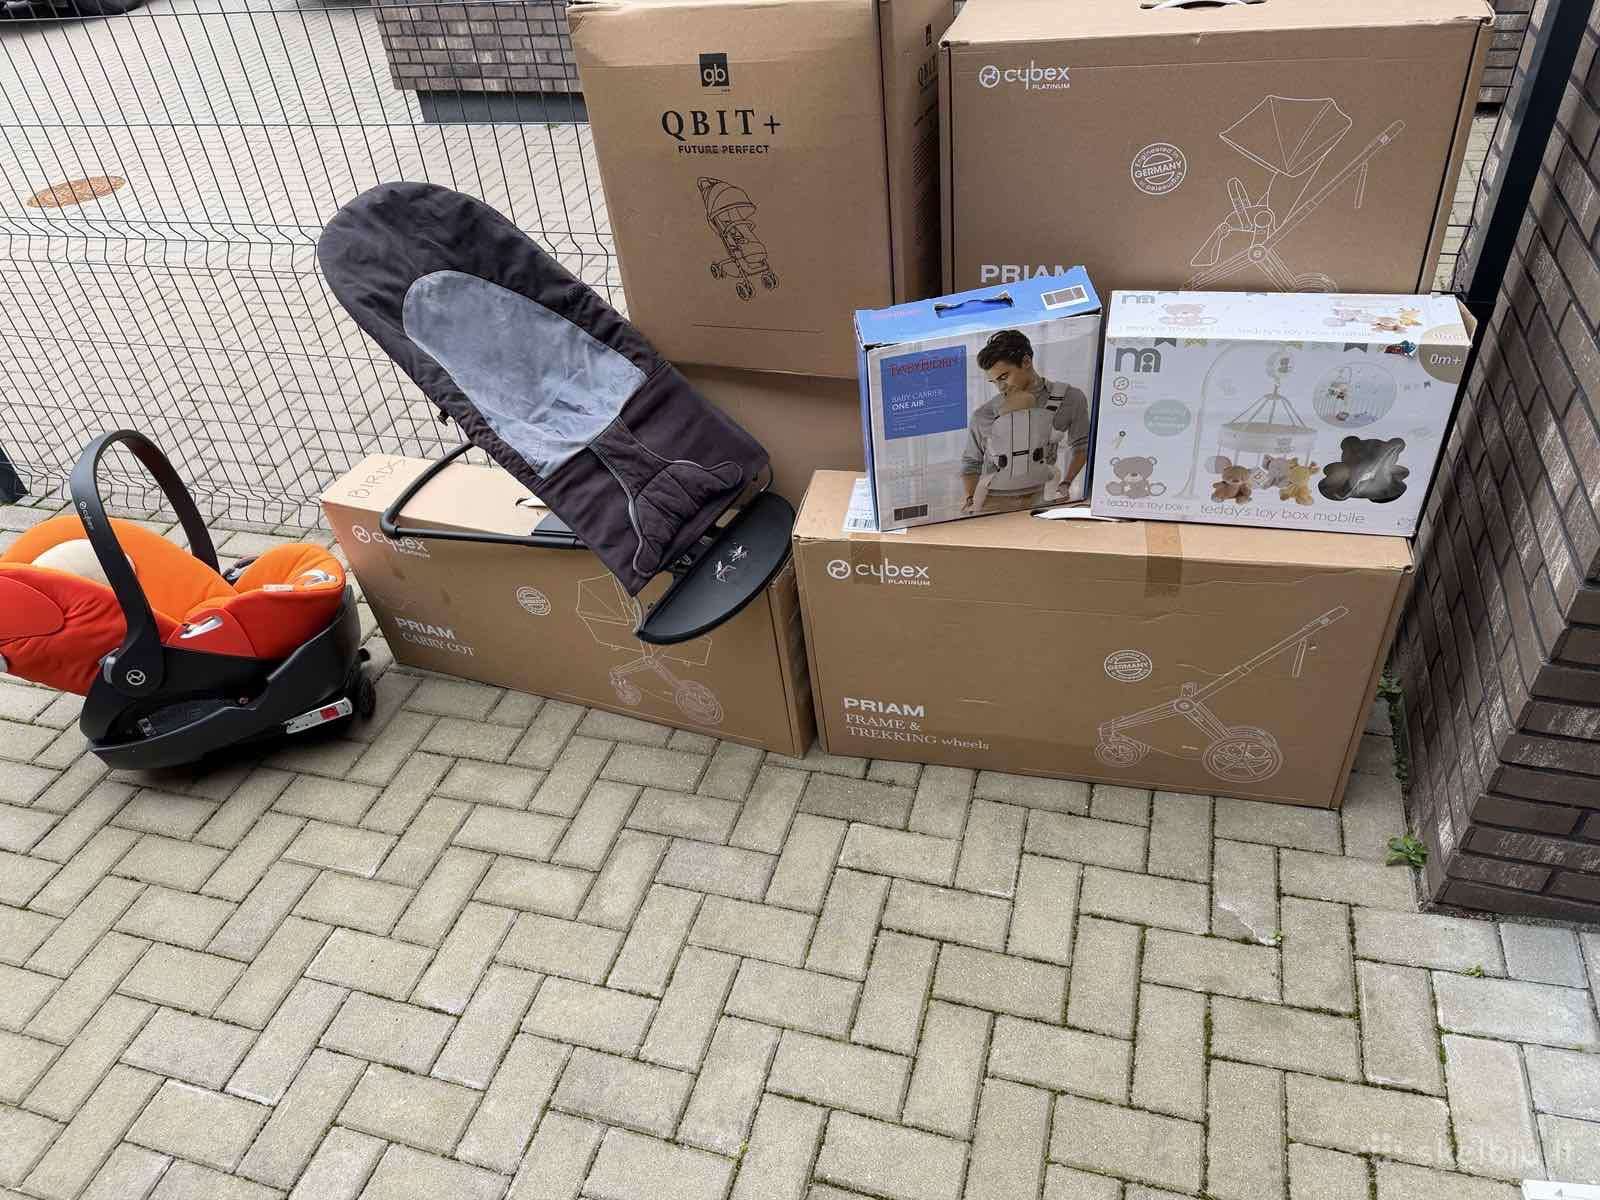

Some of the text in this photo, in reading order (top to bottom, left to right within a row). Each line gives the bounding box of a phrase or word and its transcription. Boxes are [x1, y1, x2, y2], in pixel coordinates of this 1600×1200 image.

[703, 63, 726, 87] gb
[1004, 59, 1070, 90] cybex
[678, 144, 769, 155] FUTURE PERFECT
[1134, 160, 1182, 178] GERMANY
[892, 400, 924, 411] ONE AIR
[1200, 504, 1366, 524] teddy's toy box mobile
[856, 558, 929, 583] cybex
[393, 616, 456, 640] PRIAM
[402, 632, 474, 656] CARRY COT
[844, 697, 925, 717] PRIAM
[846, 713, 921, 731] FRAME &
[848, 726, 990, 750] TREKKING wheels
